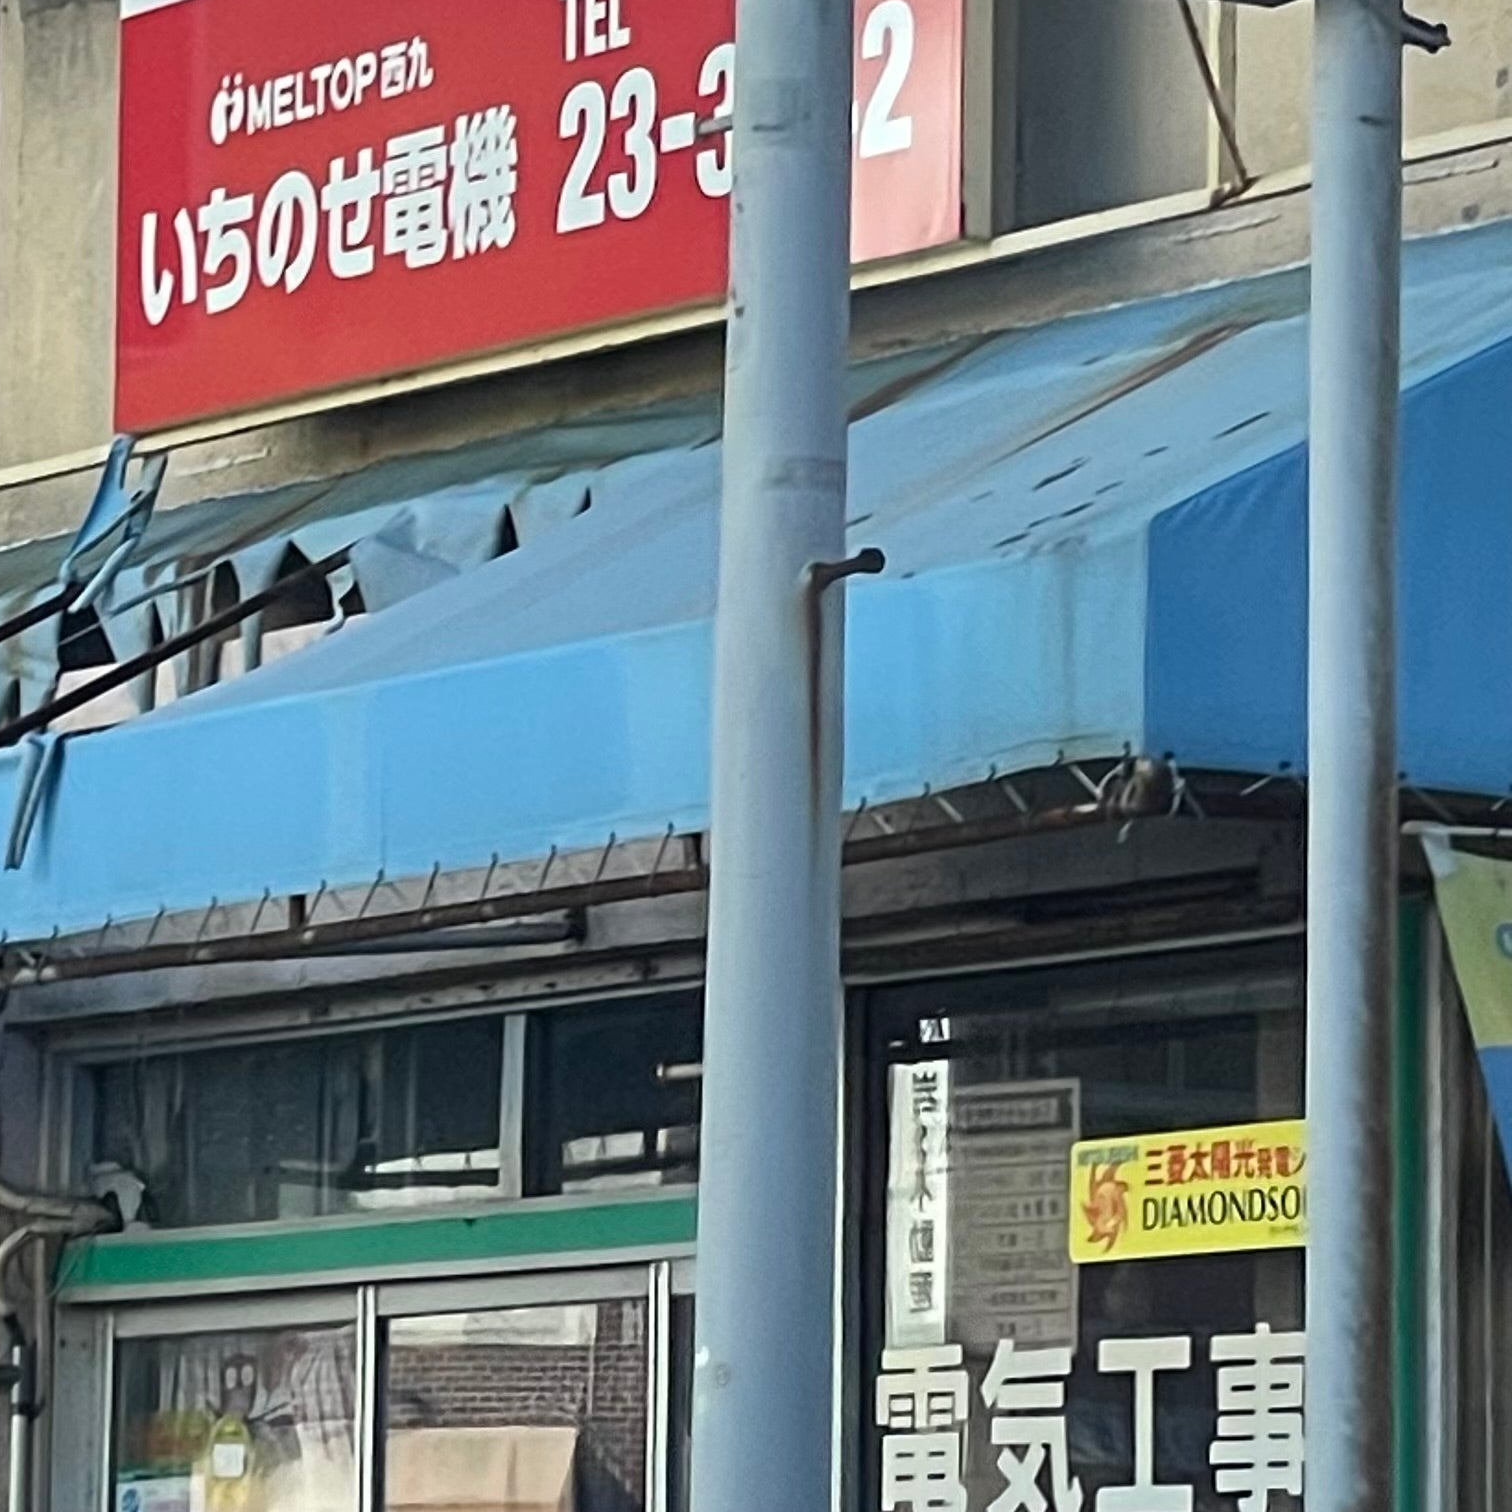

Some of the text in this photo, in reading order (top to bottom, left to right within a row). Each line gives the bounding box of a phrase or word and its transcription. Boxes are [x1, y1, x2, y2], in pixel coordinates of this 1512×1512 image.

[555, 0, 915, 234] 23-32
[140, 104, 519, 326] いちのせ電機
[1142, 1184, 1308, 1232] DIAMONDSO
[1143, 1138, 1307, 1187] 三菱太陽光発電シ
